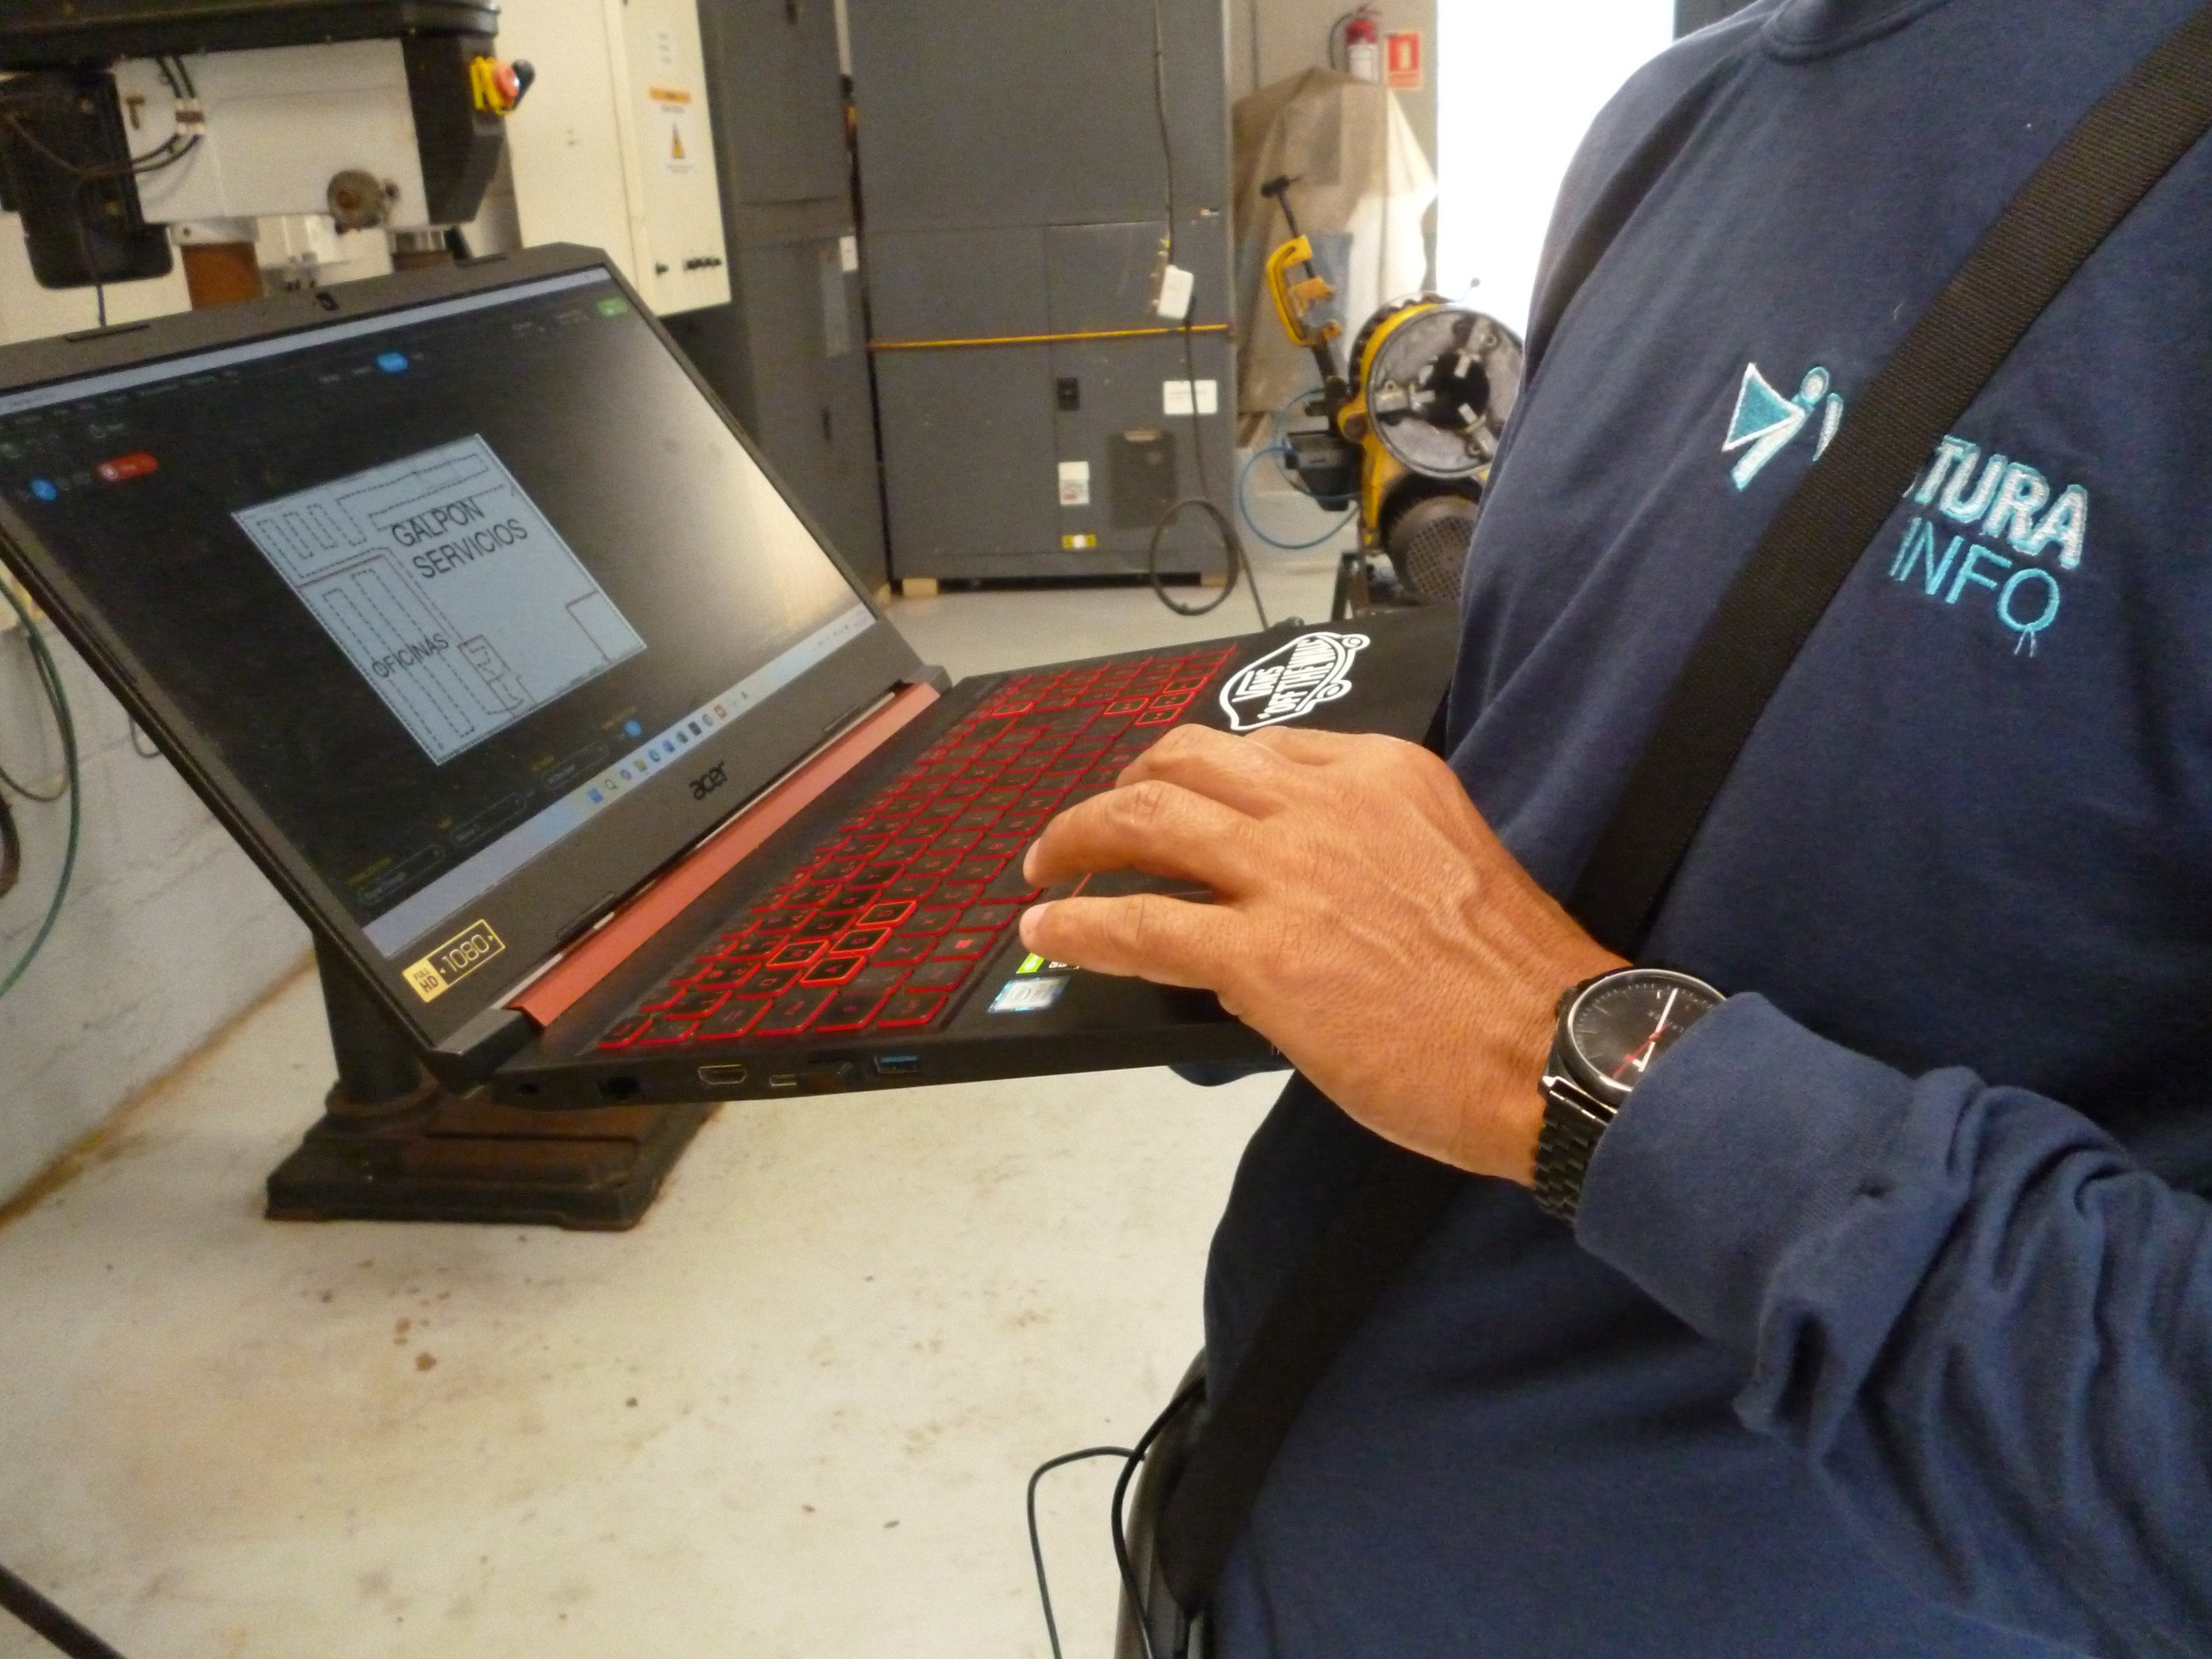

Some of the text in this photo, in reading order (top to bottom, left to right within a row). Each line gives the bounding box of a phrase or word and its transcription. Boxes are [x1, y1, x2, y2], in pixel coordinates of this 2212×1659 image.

[391, 497, 486, 547] GALPON
[1903, 434, 2088, 570] TURA
[412, 518, 528, 578] SERVICIOS
[1889, 517, 2061, 635] INFO
[372, 633, 449, 678] OFICINAS
[1232, 665, 1286, 702] VANS
[1274, 662, 1335, 692] THE
[689, 760, 728, 800] acer
[442, 933, 490, 973] 1080
[413, 967, 431, 982] FULL
[418, 975, 440, 994] HD
